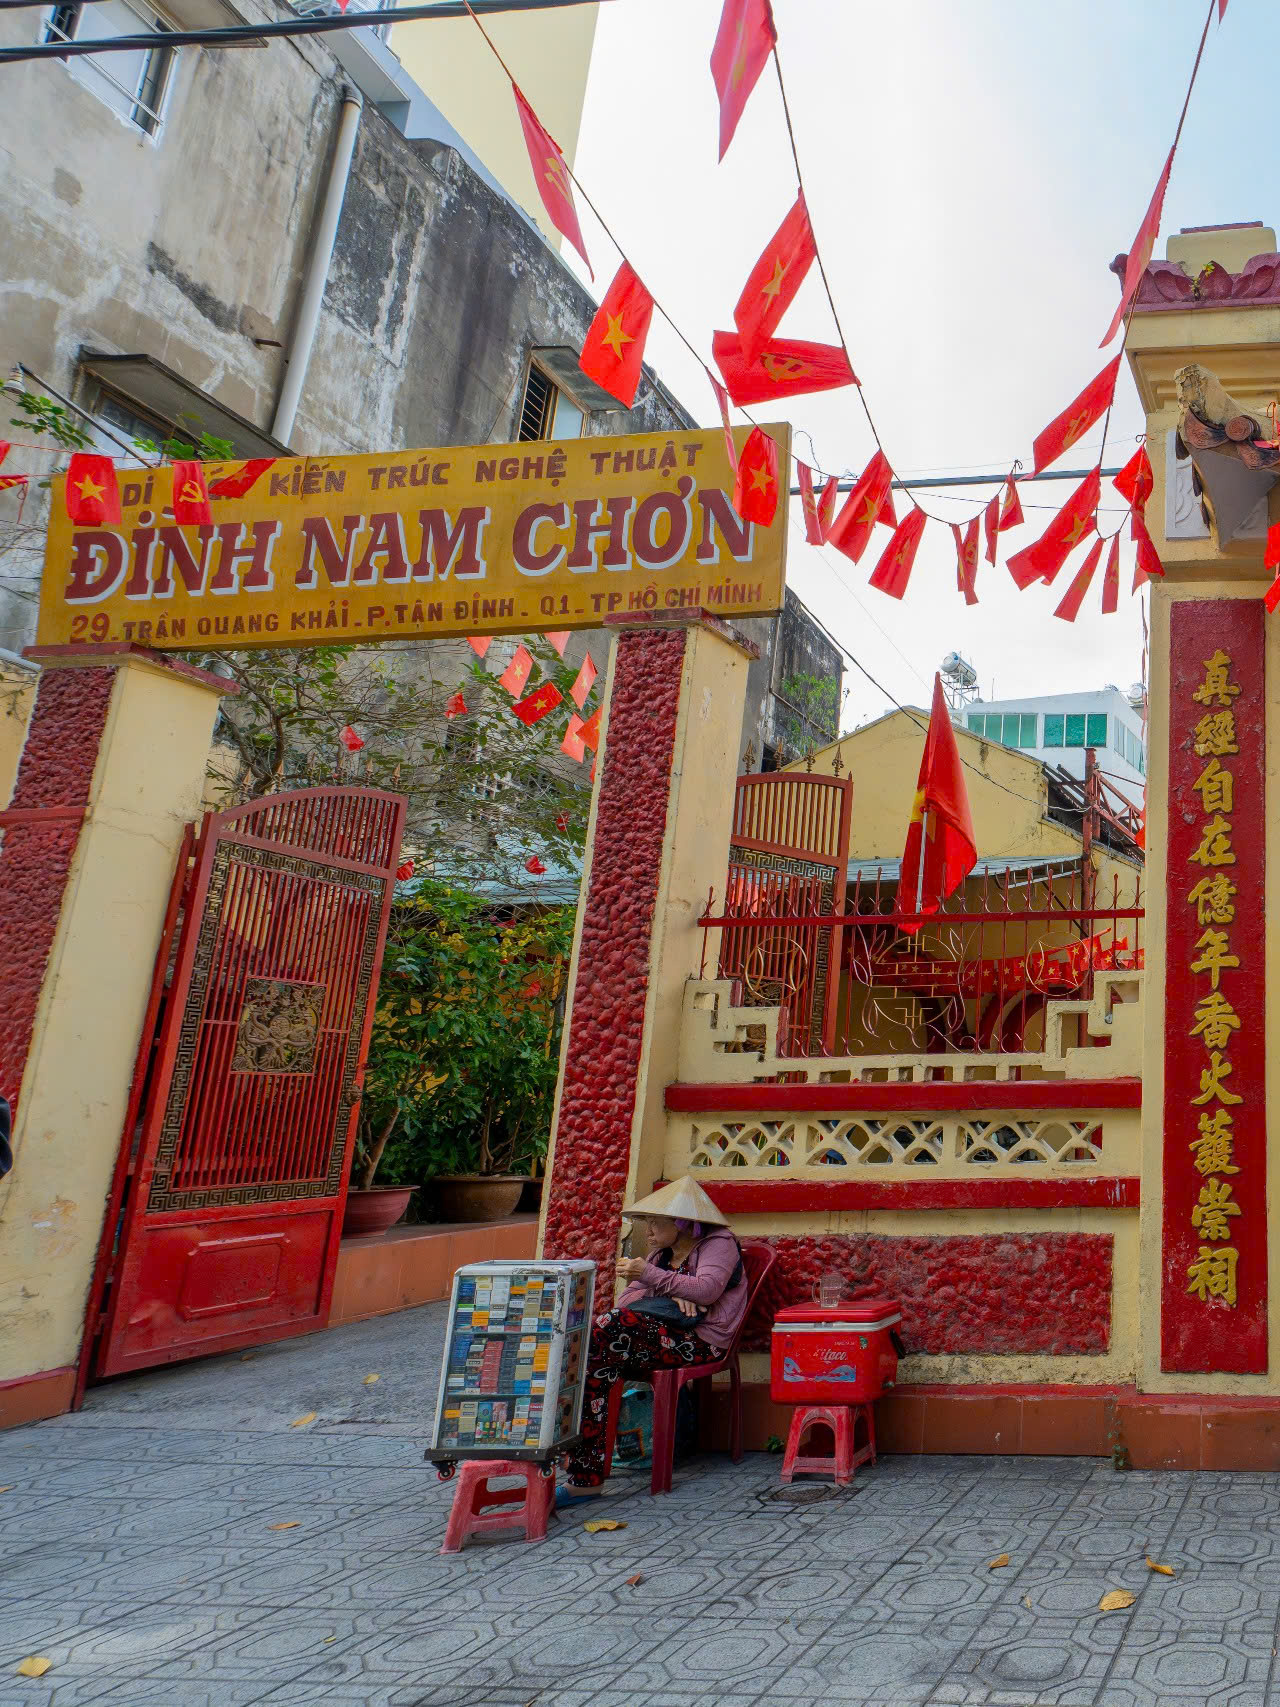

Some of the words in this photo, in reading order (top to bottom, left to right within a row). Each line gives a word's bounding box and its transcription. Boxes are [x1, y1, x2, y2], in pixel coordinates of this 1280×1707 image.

[269, 462, 347, 497] KIẾN
[367, 456, 451, 491] TRÚC
[475, 447, 568, 488] NGHỆ
[590, 440, 703, 478] THUẬT
[64, 505, 283, 605] ĐÌNH
[294, 505, 492, 591] NAM
[512, 475, 755, 577] CHƠN
[197, 613, 279, 637] QUANG
[590, 591, 623, 613] TP
[627, 581, 658, 610] HỒ
[664, 581, 702, 608] CHÍ
[706, 577, 763, 605] MINH
